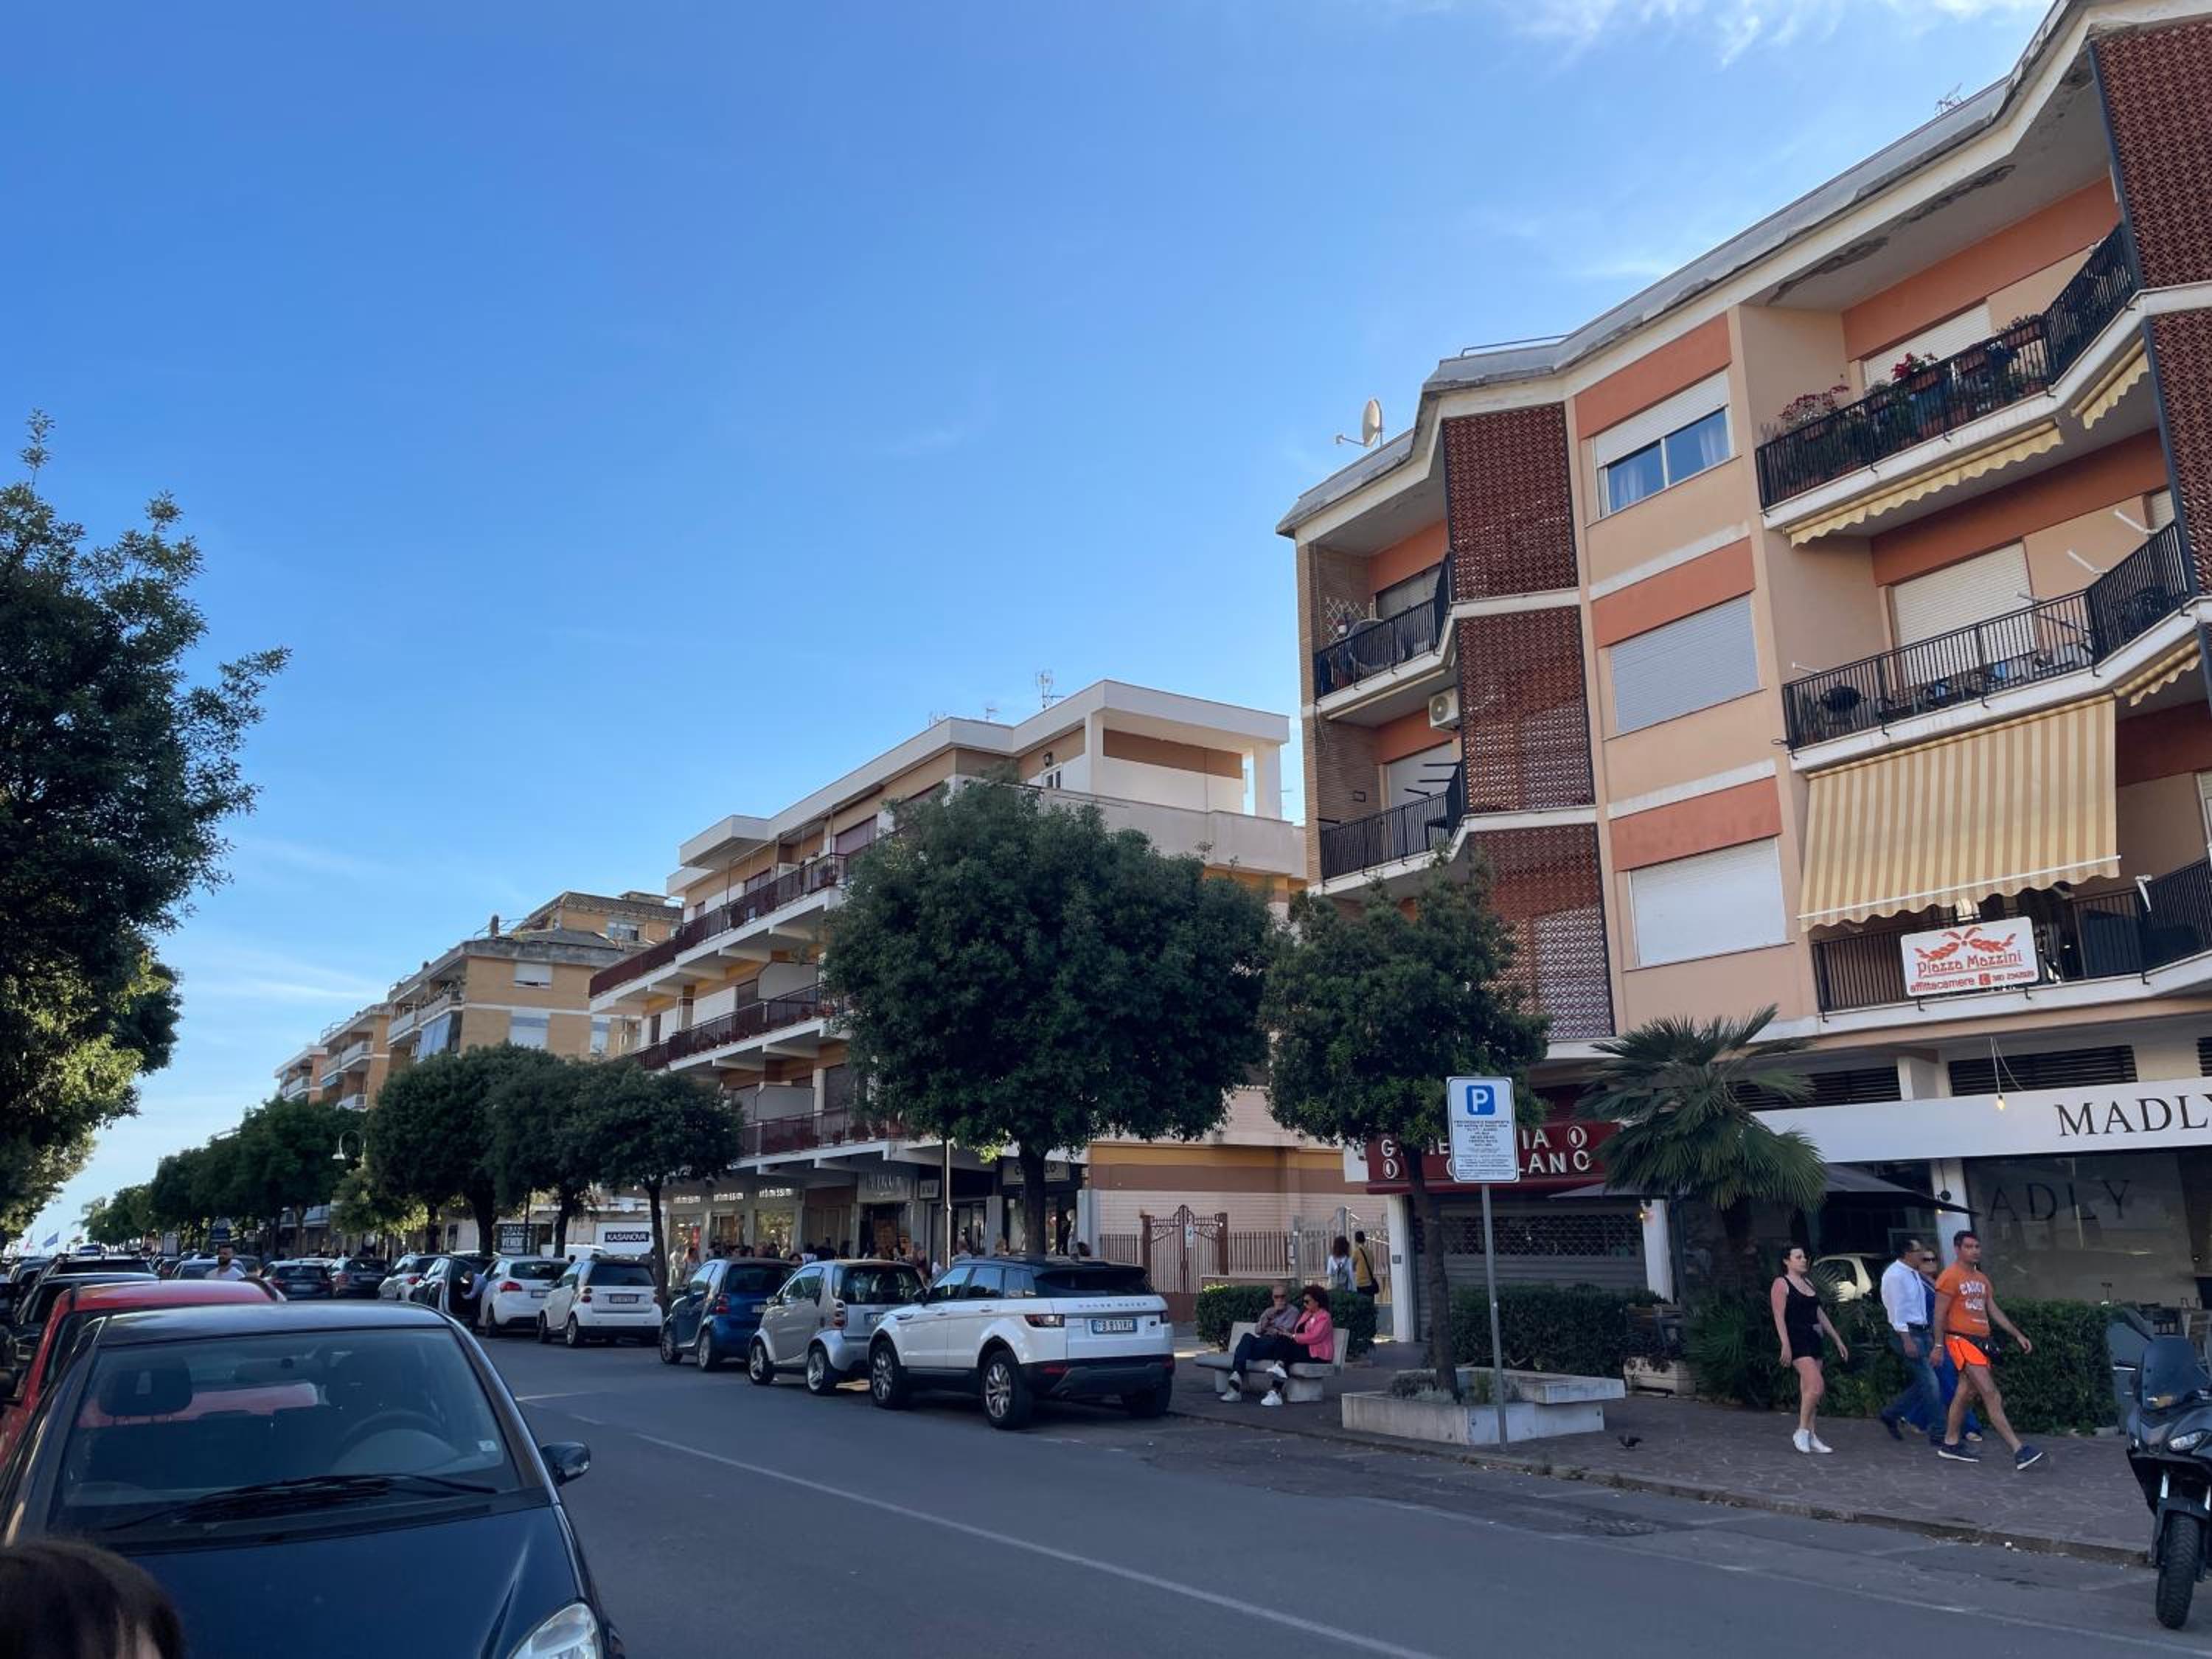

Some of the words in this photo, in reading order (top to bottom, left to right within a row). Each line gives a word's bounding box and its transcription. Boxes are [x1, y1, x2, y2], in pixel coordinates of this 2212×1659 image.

[1917, 960, 1963, 978] Piazza
[1967, 950, 2023, 968] Mazzini
[2054, 1093, 2212, 1136] MADL
[607, 1233, 647, 1241] KASANOVA
